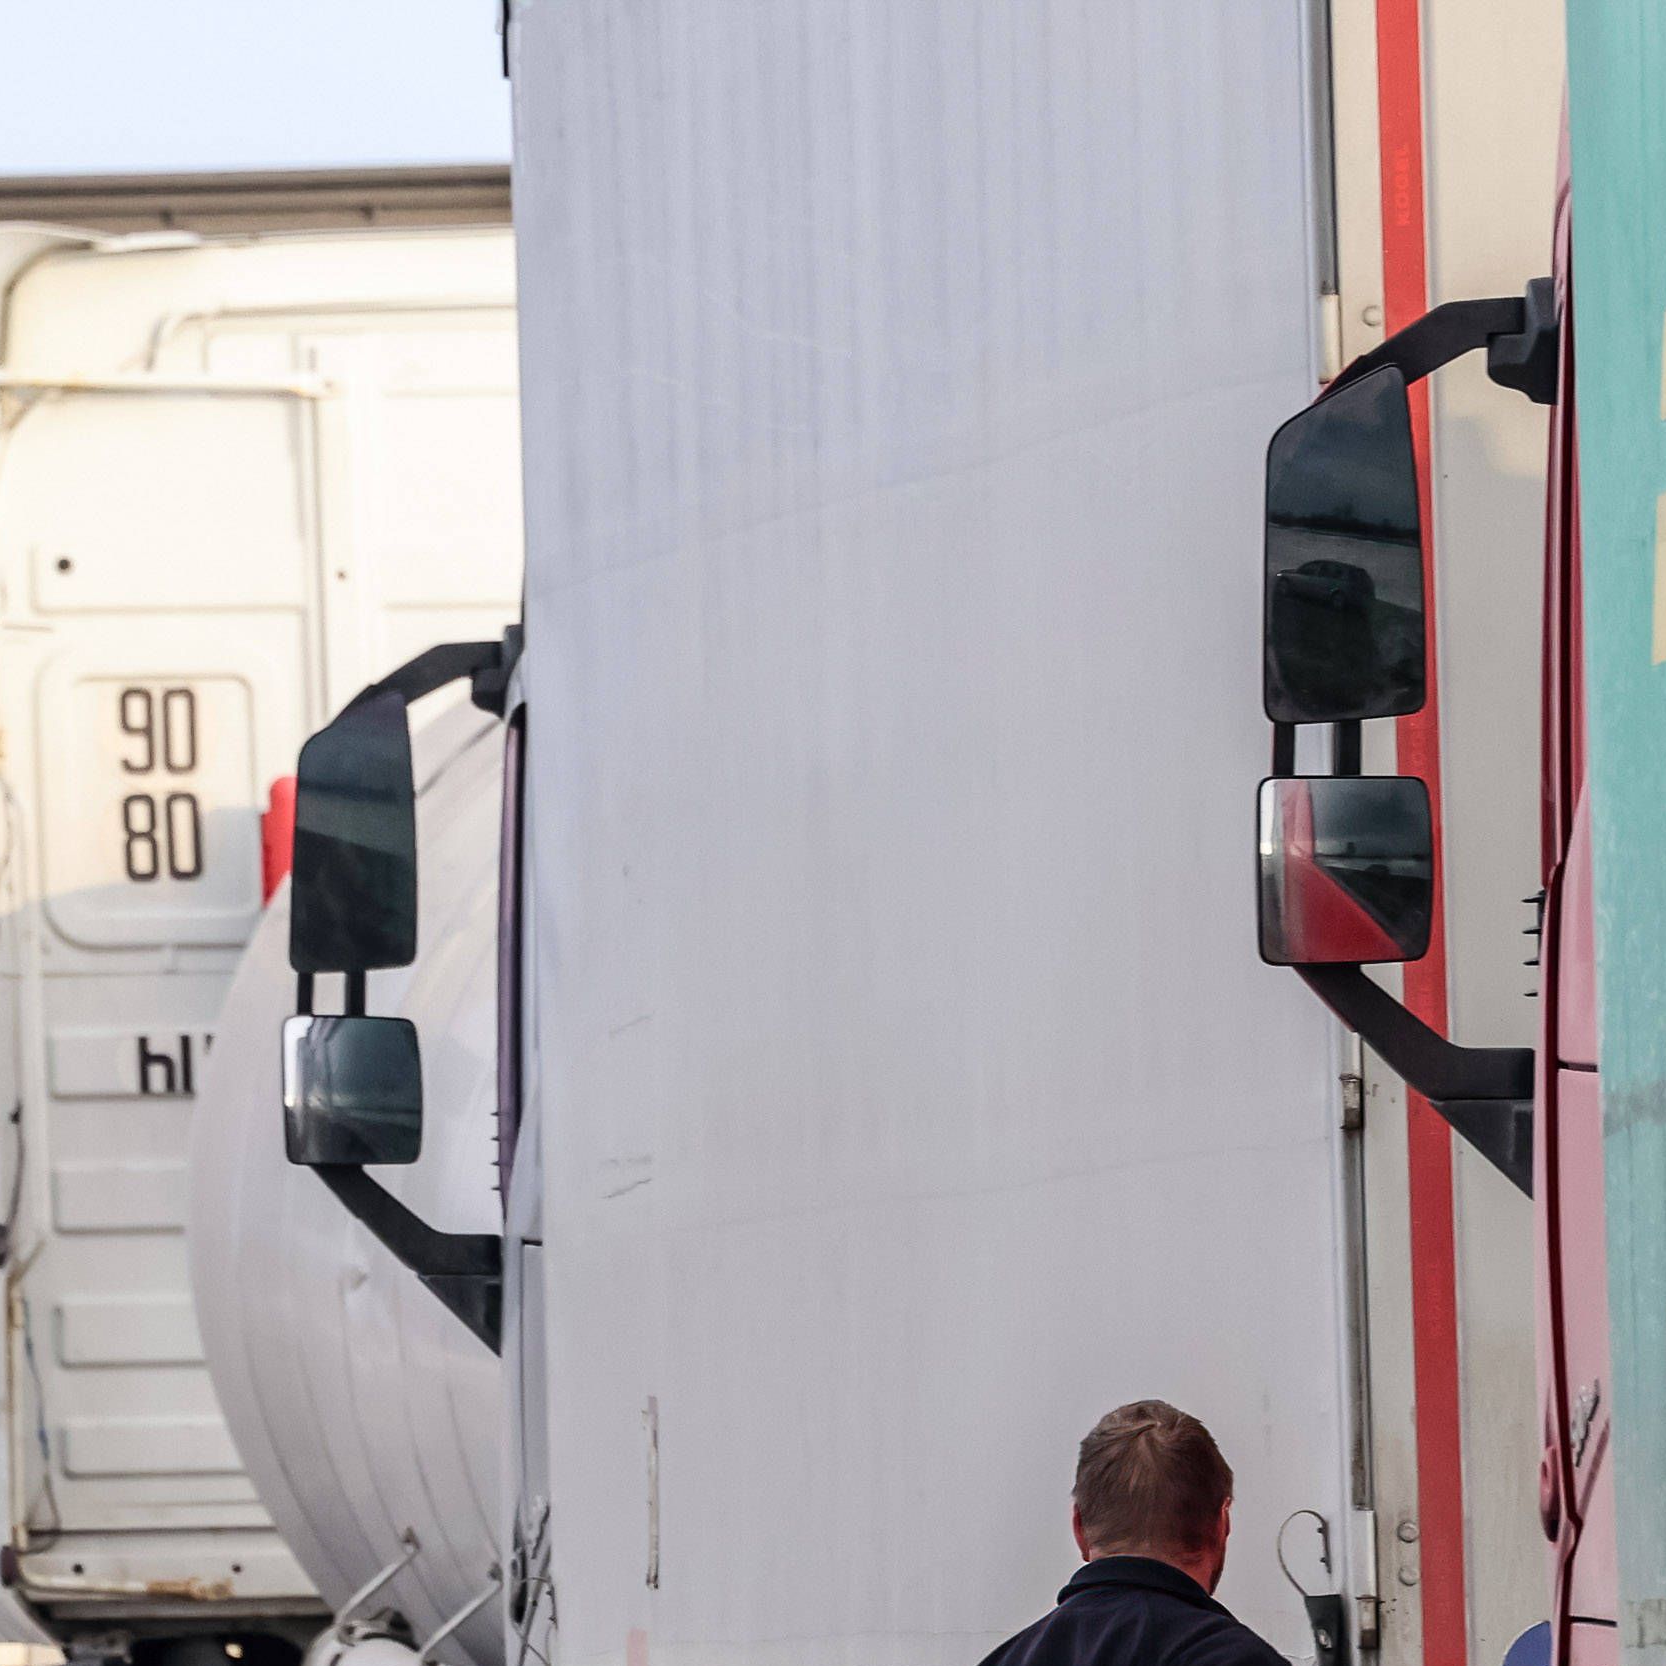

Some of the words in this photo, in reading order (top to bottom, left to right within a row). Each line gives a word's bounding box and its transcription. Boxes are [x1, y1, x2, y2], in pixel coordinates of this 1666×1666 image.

[120, 687, 197, 774] 90
[123, 793, 202, 881] 80
[137, 1034, 213, 1095] hl
